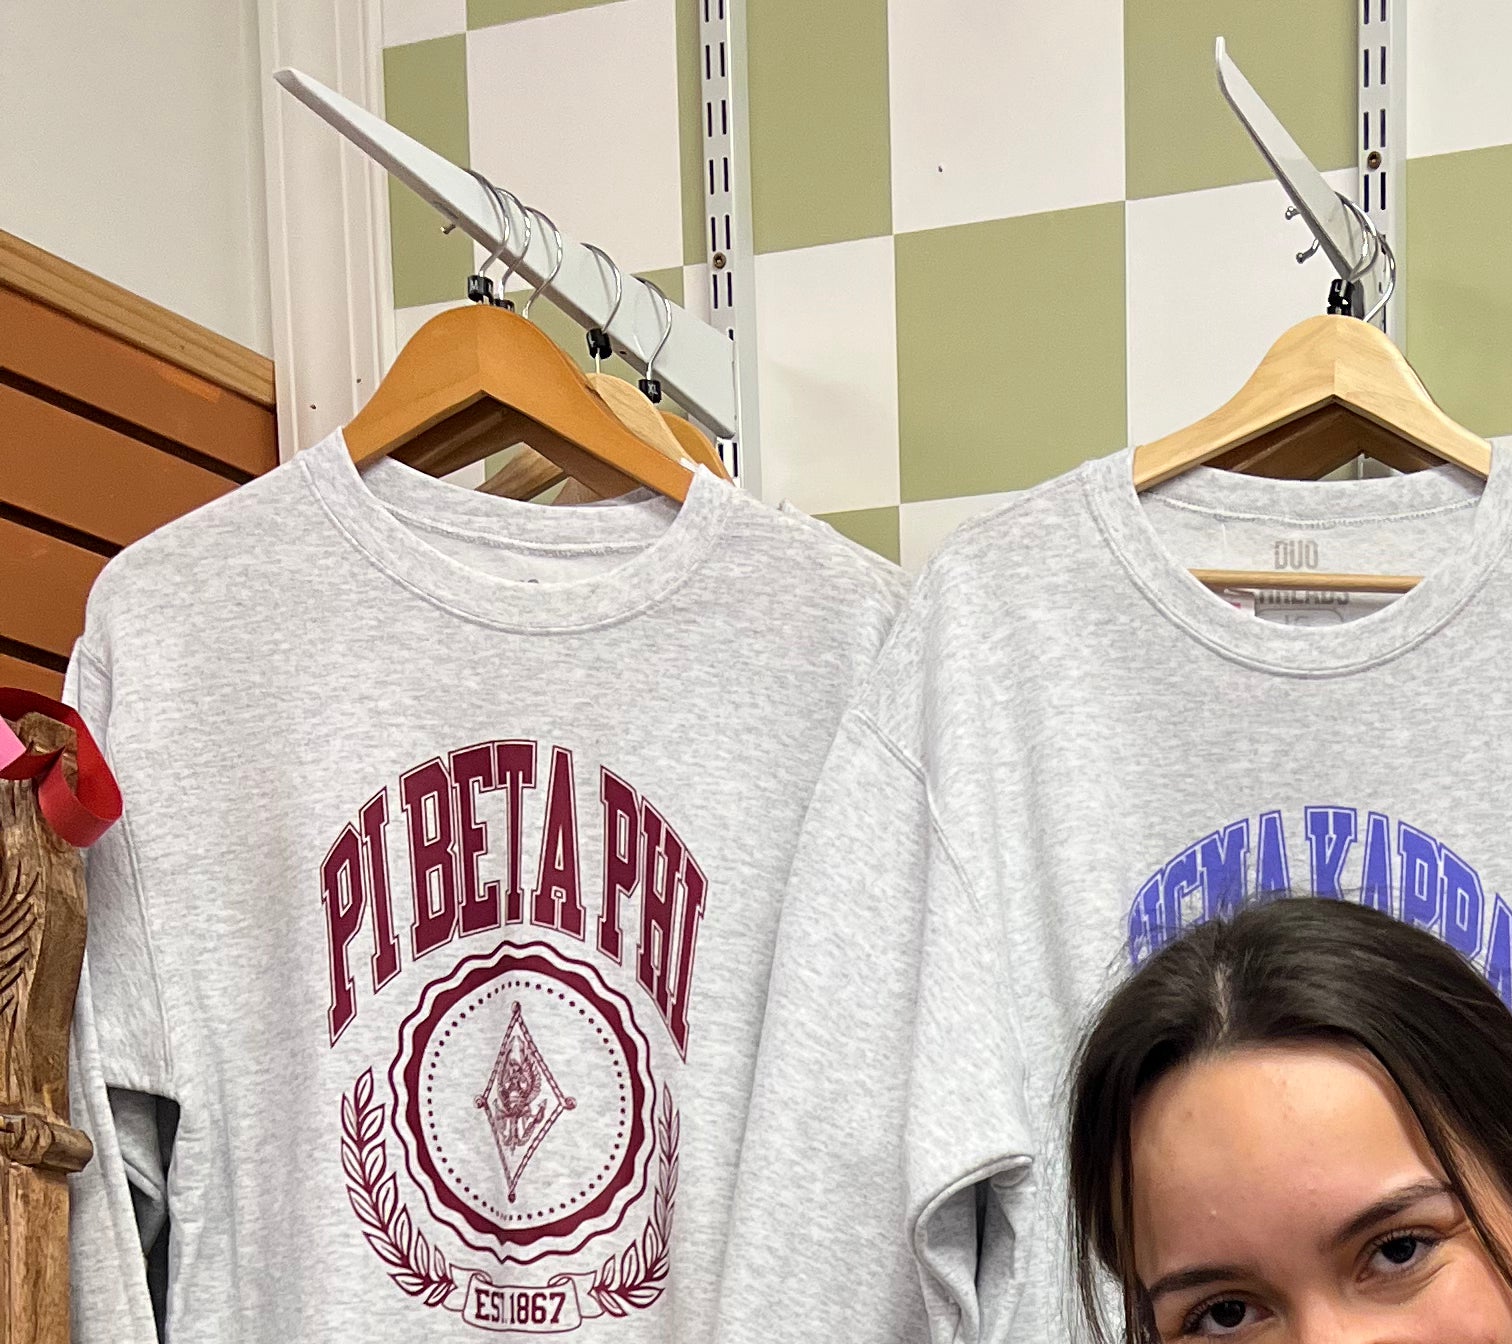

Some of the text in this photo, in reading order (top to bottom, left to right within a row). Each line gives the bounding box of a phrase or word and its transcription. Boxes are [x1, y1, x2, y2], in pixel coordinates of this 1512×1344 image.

[1273, 539, 1320, 570] DUO
[319, 739, 709, 1064] PI BETA PHI
